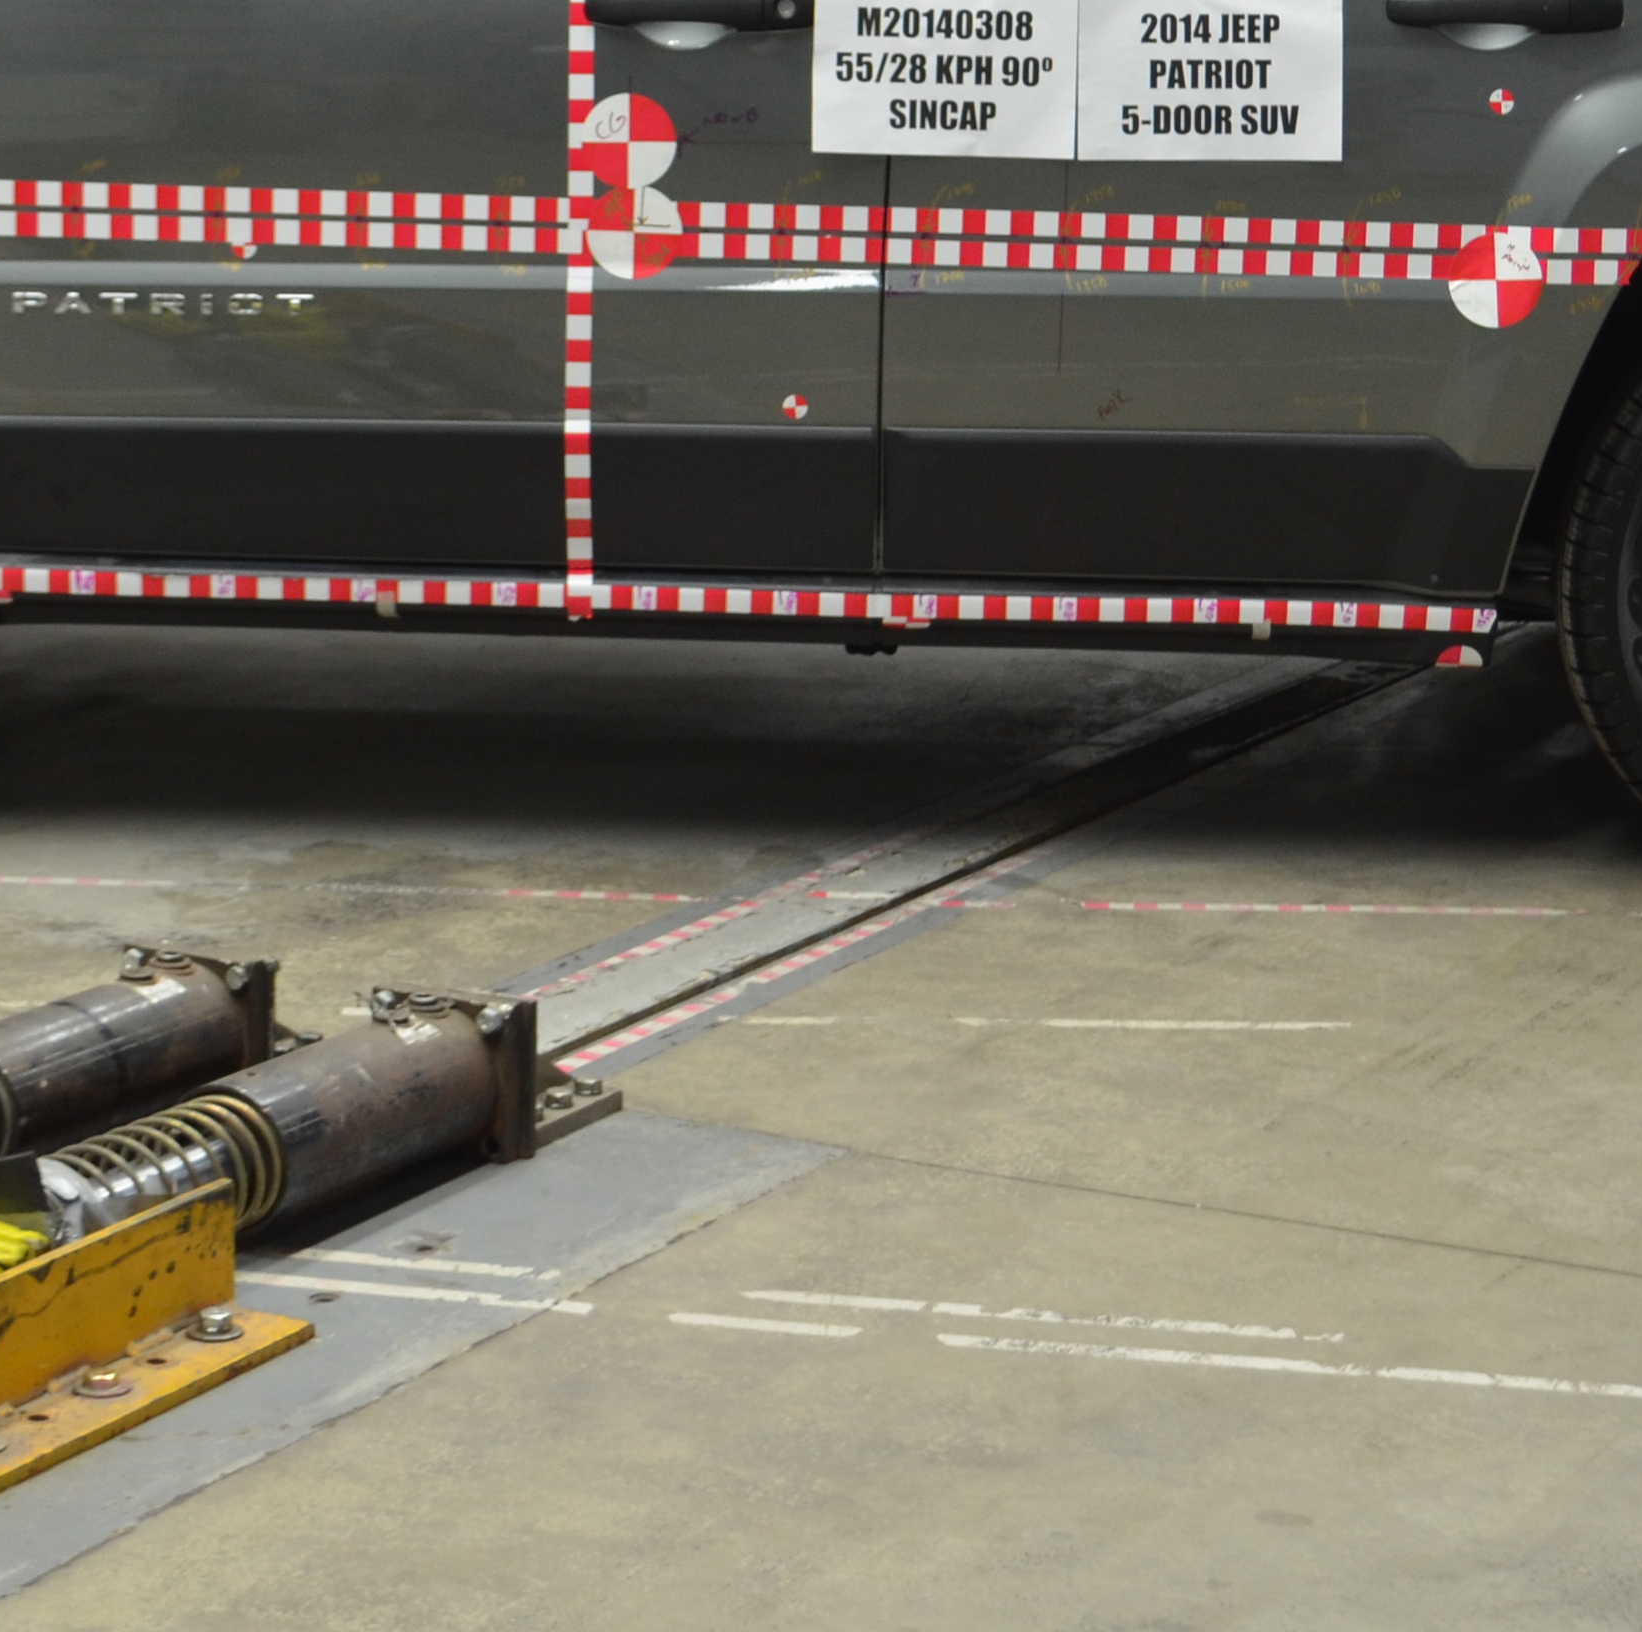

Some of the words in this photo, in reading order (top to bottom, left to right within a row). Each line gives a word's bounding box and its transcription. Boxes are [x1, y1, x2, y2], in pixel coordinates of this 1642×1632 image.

[857, 7, 1033, 41] M20140308
[1141, 13, 1212, 44] 2014
[1218, 14, 1280, 44] JEEP
[835, 52, 927, 84] 55/28
[935, 54, 993, 86] KPH
[1149, 59, 1272, 90] PATRIOT
[595, 111, 627, 139] CG
[889, 99, 997, 131] SINCAP
[1122, 104, 1232, 135] 5-DOOR
[1240, 104, 1299, 135] SUV
[10, 290, 314, 316] PATRIOT
